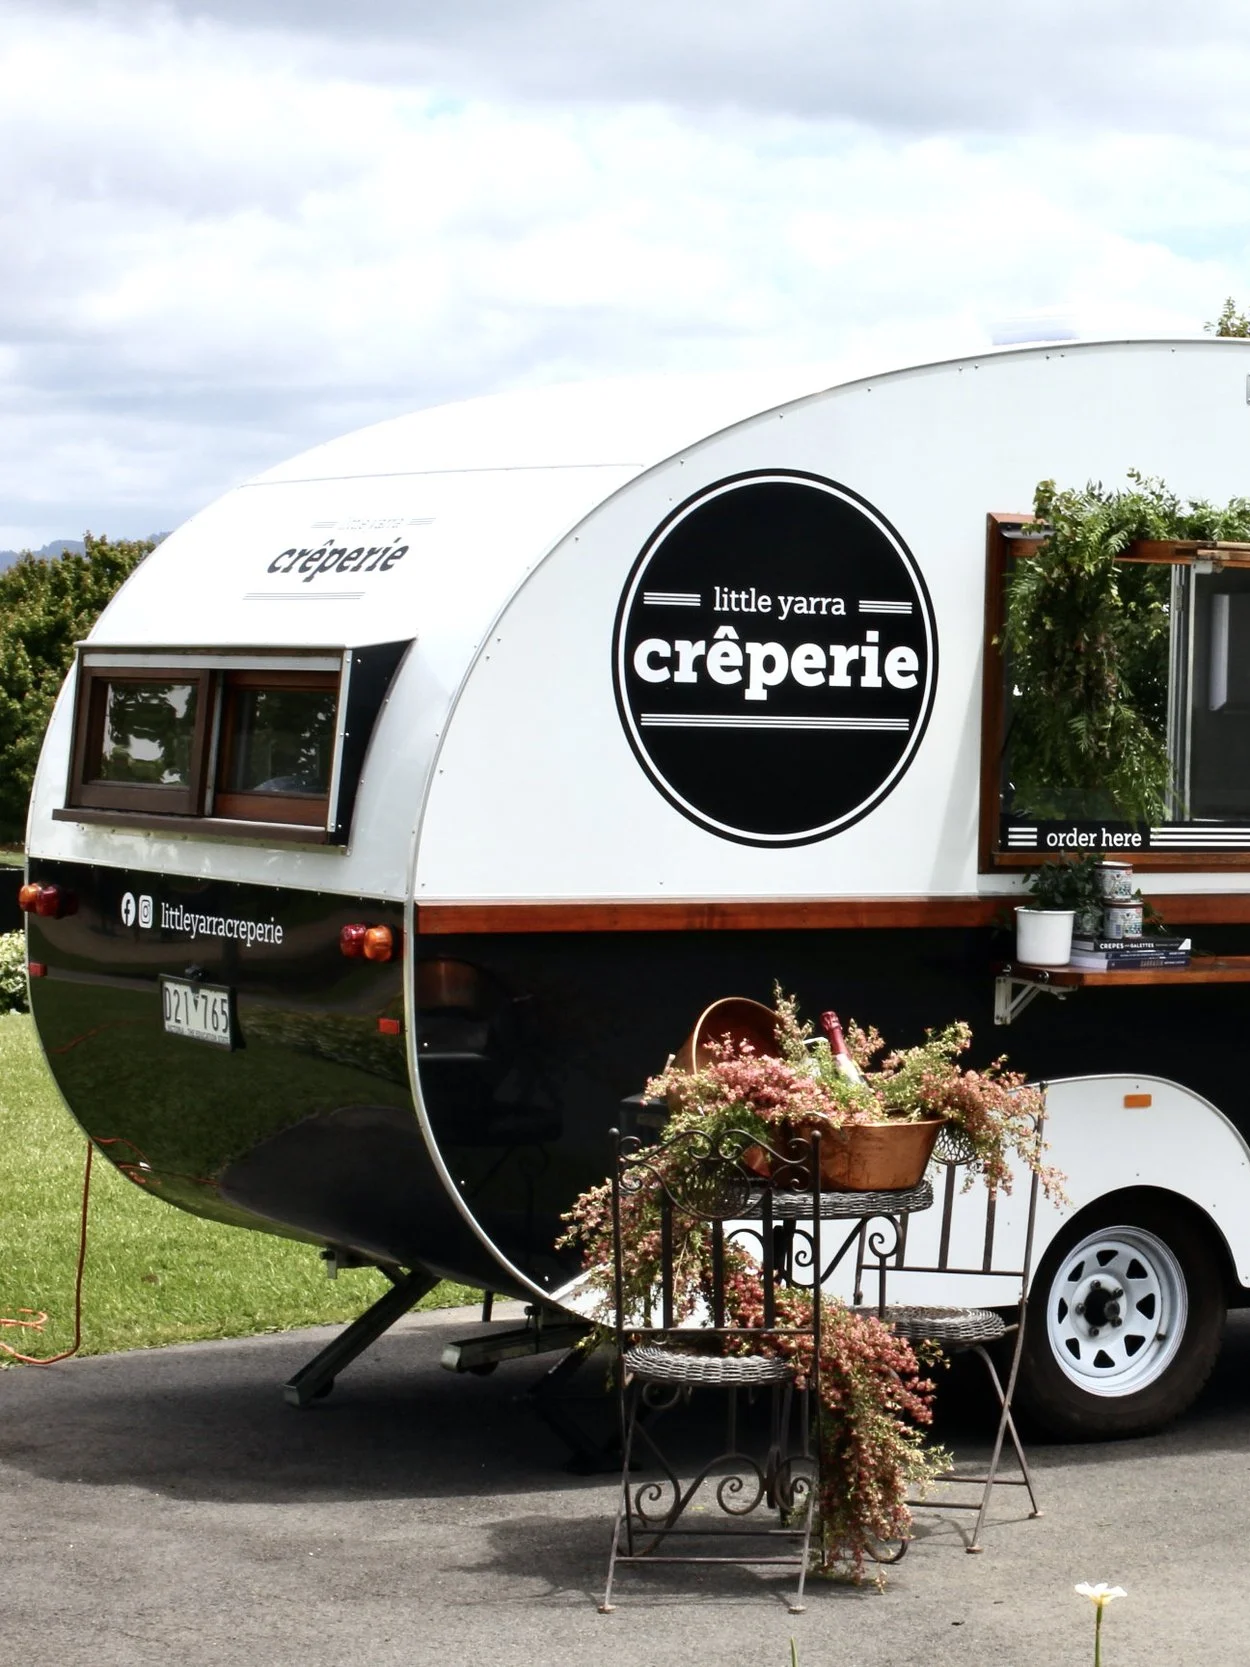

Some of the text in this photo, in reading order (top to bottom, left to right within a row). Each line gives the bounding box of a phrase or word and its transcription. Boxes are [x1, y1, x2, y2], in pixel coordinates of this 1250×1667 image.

[267, 537, 409, 583] crêperie
[713, 587, 846, 621] little yarra
[633, 625, 919, 701] crêperie
[1046, 827, 1142, 847] order here
[161, 902, 283, 947] littleyarracreperie
